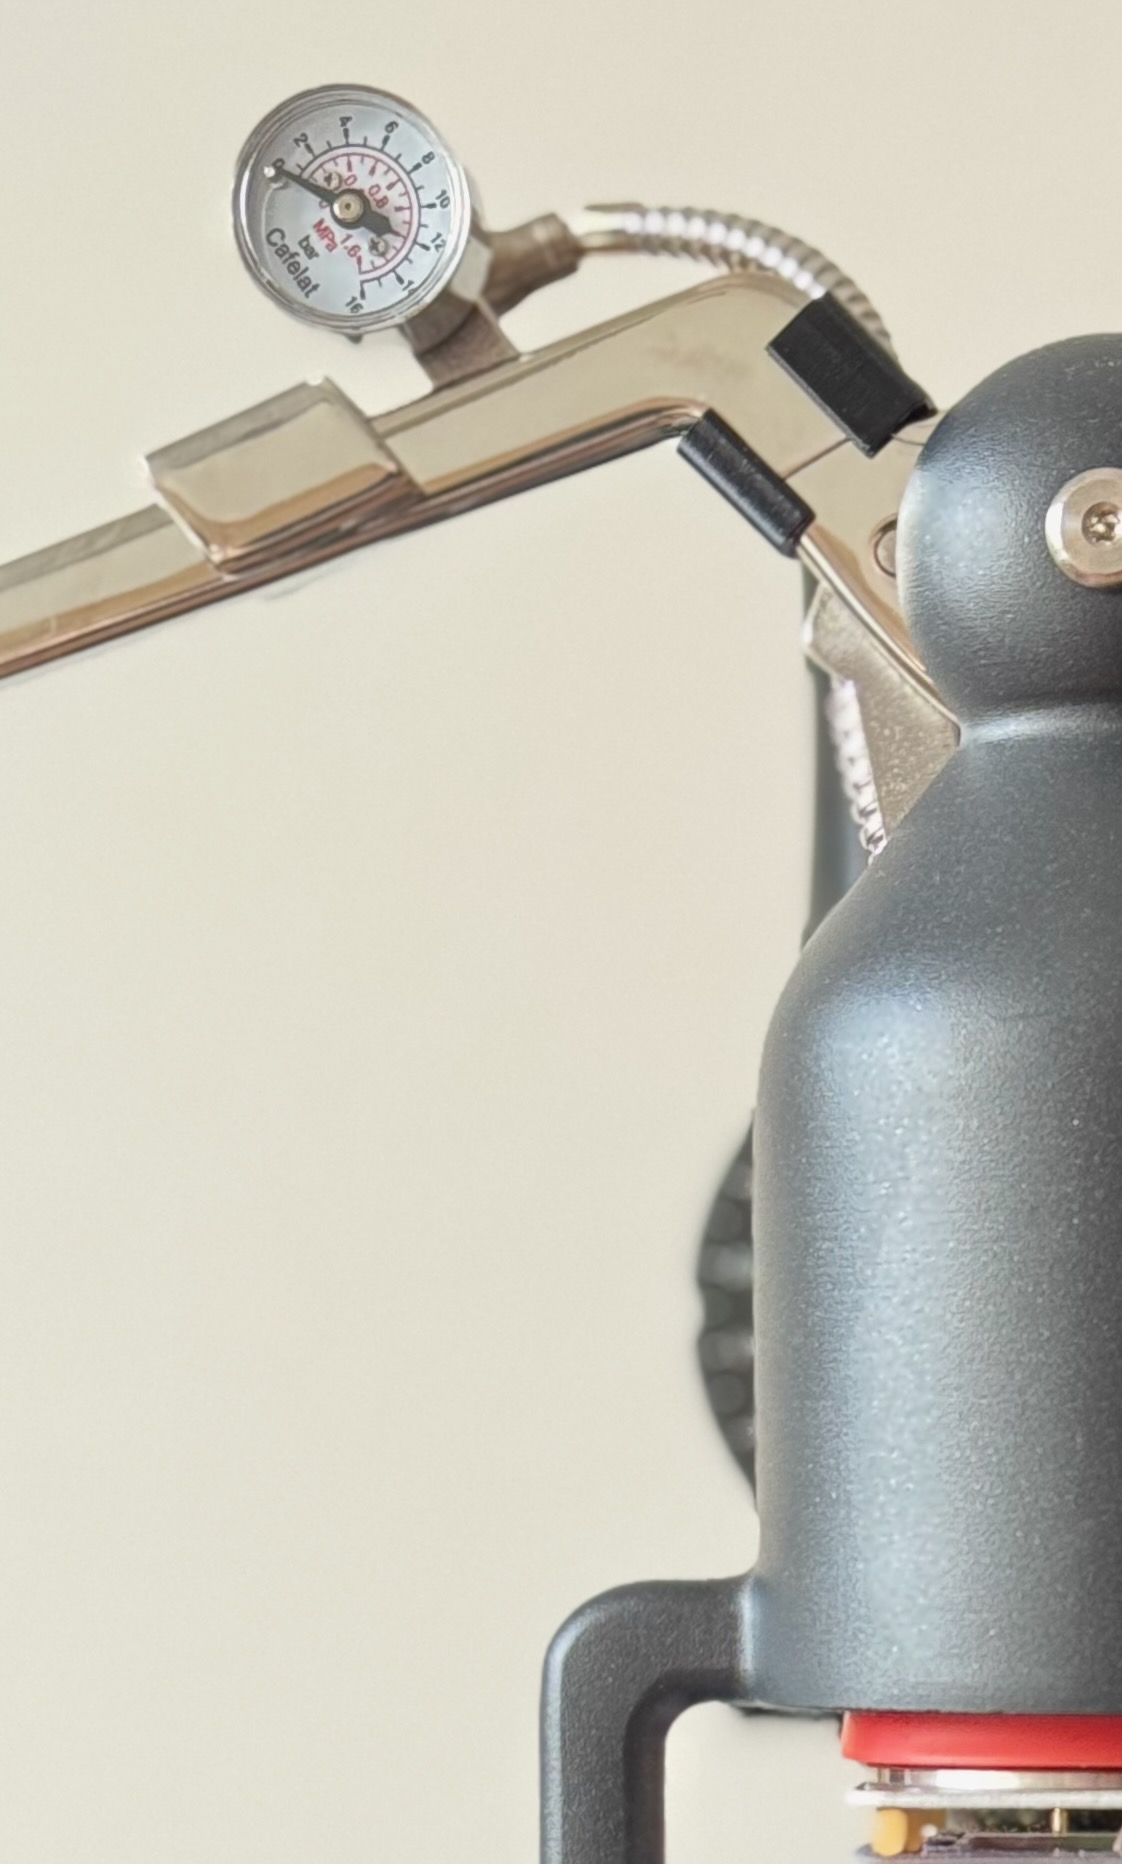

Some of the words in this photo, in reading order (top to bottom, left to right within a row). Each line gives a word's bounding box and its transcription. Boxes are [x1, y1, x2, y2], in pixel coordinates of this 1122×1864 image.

[340, 116, 352, 127] 4
[385, 121, 399, 134] 6
[294, 133, 308, 147] 2
[422, 151, 435, 164] 8
[369, 185, 389, 208] 0.8
[435, 190, 450, 209] 10
[313, 218, 337, 253] MPa
[430, 233, 446, 253] 12
[298, 235, 319, 260] bar
[341, 235, 360, 257] 1.6
[266, 228, 320, 298] Cafelat
[346, 297, 363, 314] 16
